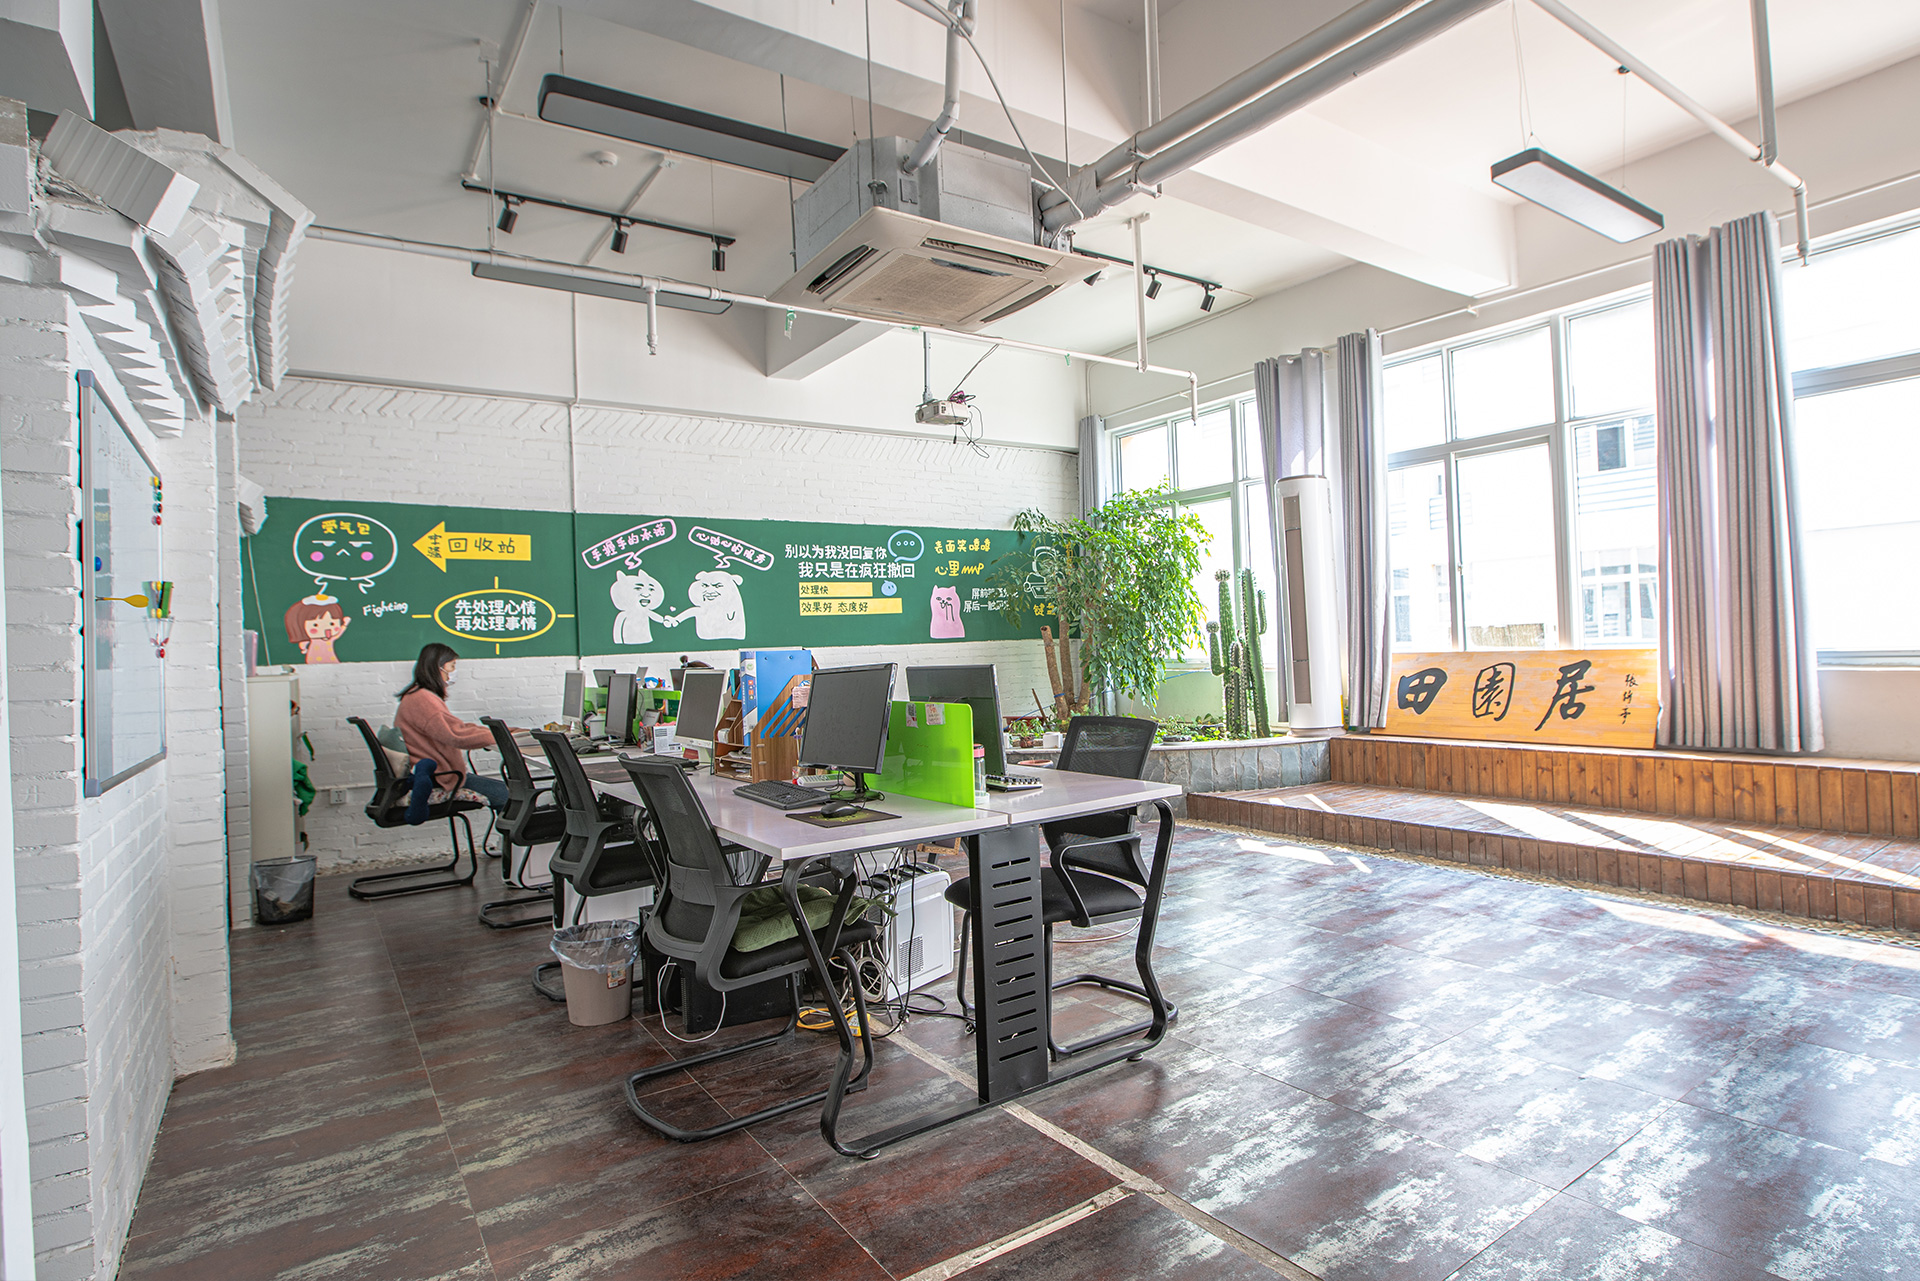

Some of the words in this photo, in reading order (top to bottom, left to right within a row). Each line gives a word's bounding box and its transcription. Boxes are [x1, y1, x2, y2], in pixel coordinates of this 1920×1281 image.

[321, 519, 370, 535] 受气包
[448, 537, 515, 553] 回收站
[591, 523, 666, 562] 手握手的承诺
[696, 532, 766, 564] 心贴心的服务
[784, 543, 888, 560] 别以为我没回复你
[798, 561, 915, 579] 我只是在疯狂撤回
[800, 585, 829, 595] 处理快
[362, 600, 408, 618] Fighting
[454, 599, 536, 615] 先处理心情
[801, 602, 832, 613] 效果好
[838, 602, 868, 613] 态度好
[454, 616, 537, 631] 再处理事情
